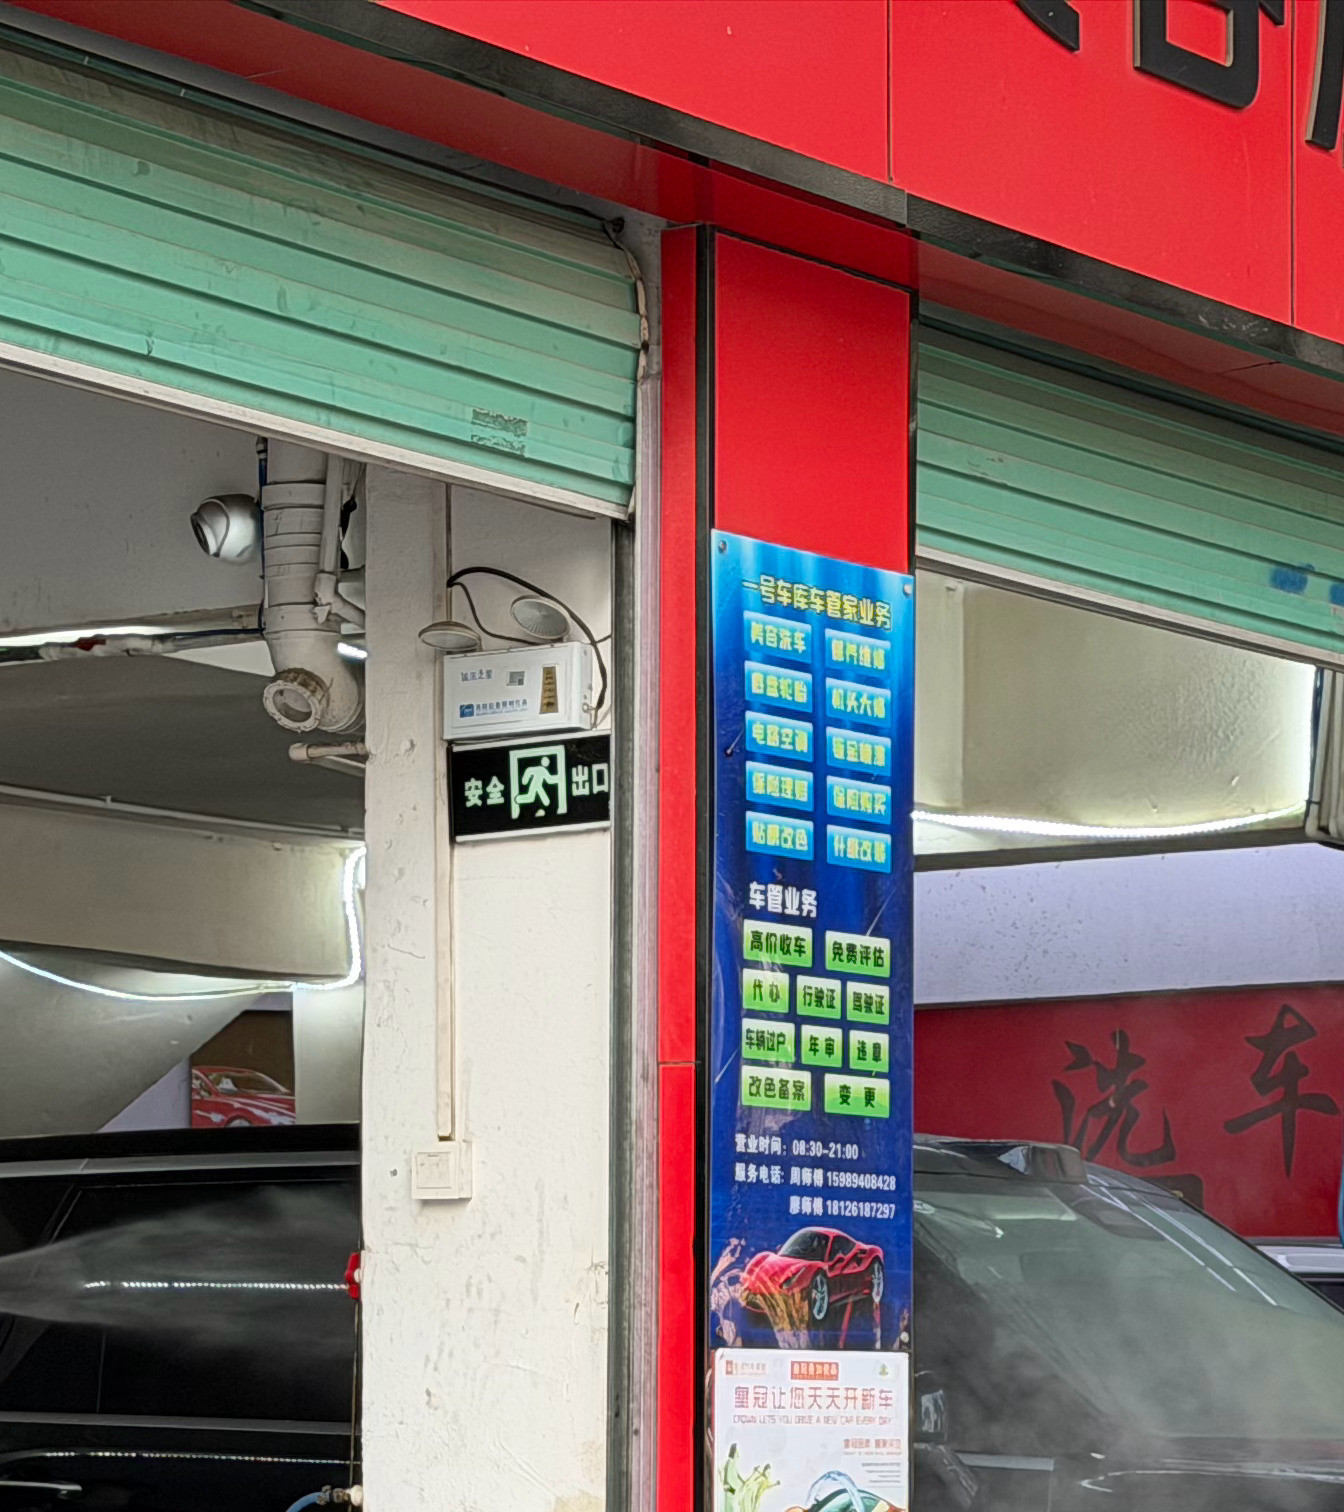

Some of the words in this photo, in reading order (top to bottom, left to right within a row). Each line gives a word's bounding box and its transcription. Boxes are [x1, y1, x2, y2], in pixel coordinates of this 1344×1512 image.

[742, 574, 891, 631] 一号车库车管家业务
[464, 775, 505, 808] 安全
[571, 763, 609, 796] 出口
[749, 881, 818, 918] 车管业务
[750, 930, 807, 958] 高价收车
[831, 940, 885, 968] 免费评估
[802, 985, 837, 1010] 行驶证
[745, 1027, 787, 1053] 车辆过户
[808, 1034, 836, 1059] 年审
[748, 1075, 806, 1101] 改色备案
[838, 1083, 877, 1109] 变更
[792, 1139, 860, 1160] 08:30-21:00
[734, 1384, 893, 1411] 皇冠让您天天开新车
